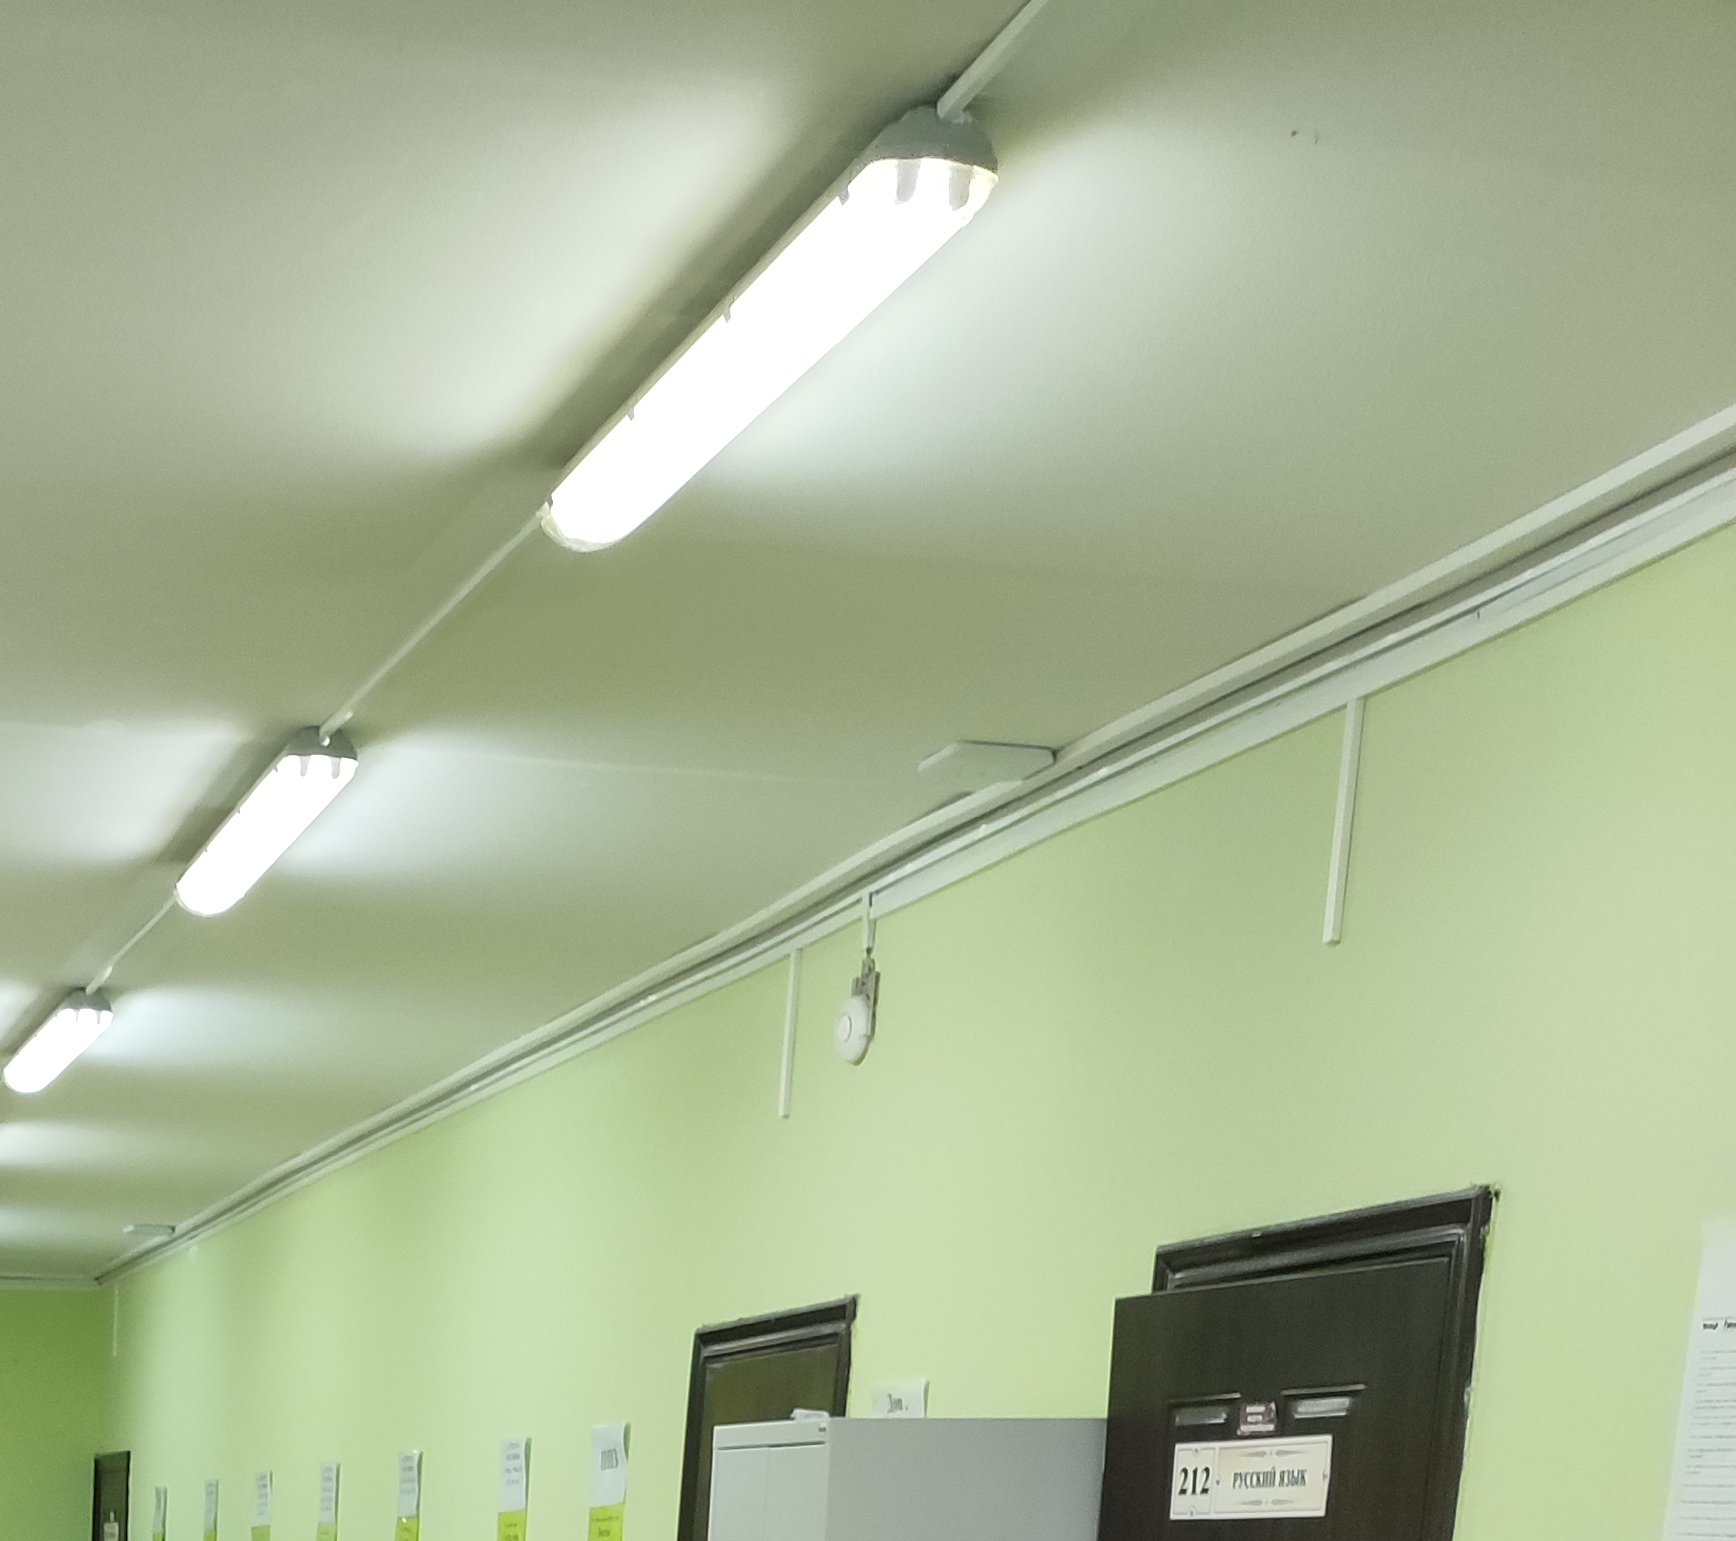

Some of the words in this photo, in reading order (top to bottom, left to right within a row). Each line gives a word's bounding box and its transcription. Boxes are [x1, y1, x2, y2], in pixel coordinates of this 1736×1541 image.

[1177, 1466, 1211, 1495] 212
[1232, 1466, 1276, 1489] РУССКИЙ
[1278, 1468, 1307, 1487] ЯЗЫК
